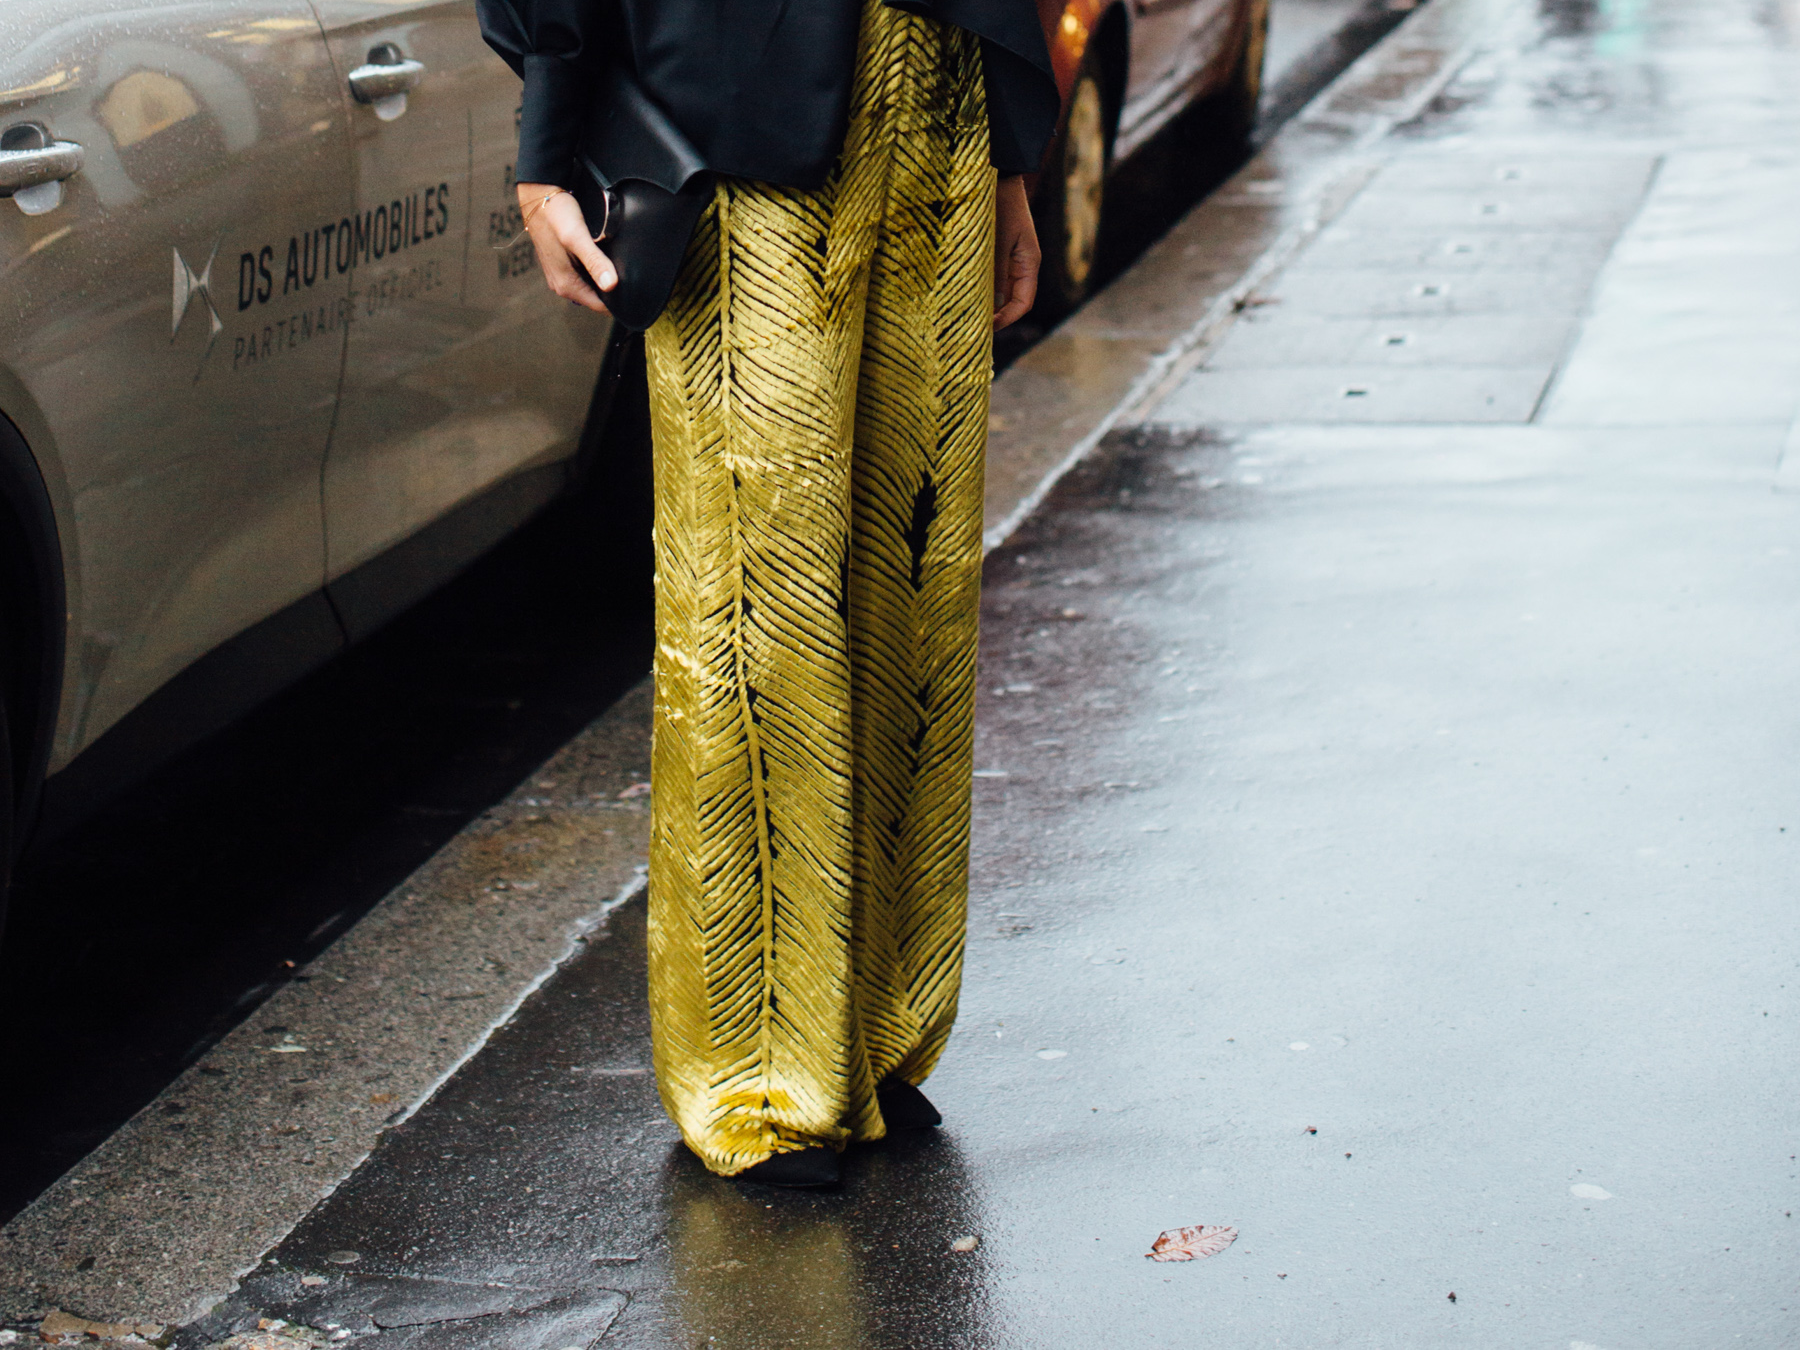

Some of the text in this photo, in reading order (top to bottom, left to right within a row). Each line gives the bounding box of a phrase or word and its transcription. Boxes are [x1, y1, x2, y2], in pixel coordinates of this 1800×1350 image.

[238, 182, 450, 312] DS AUTOMOBILES
[233, 259, 443, 370] PARTENAIRE OFFICIEL
